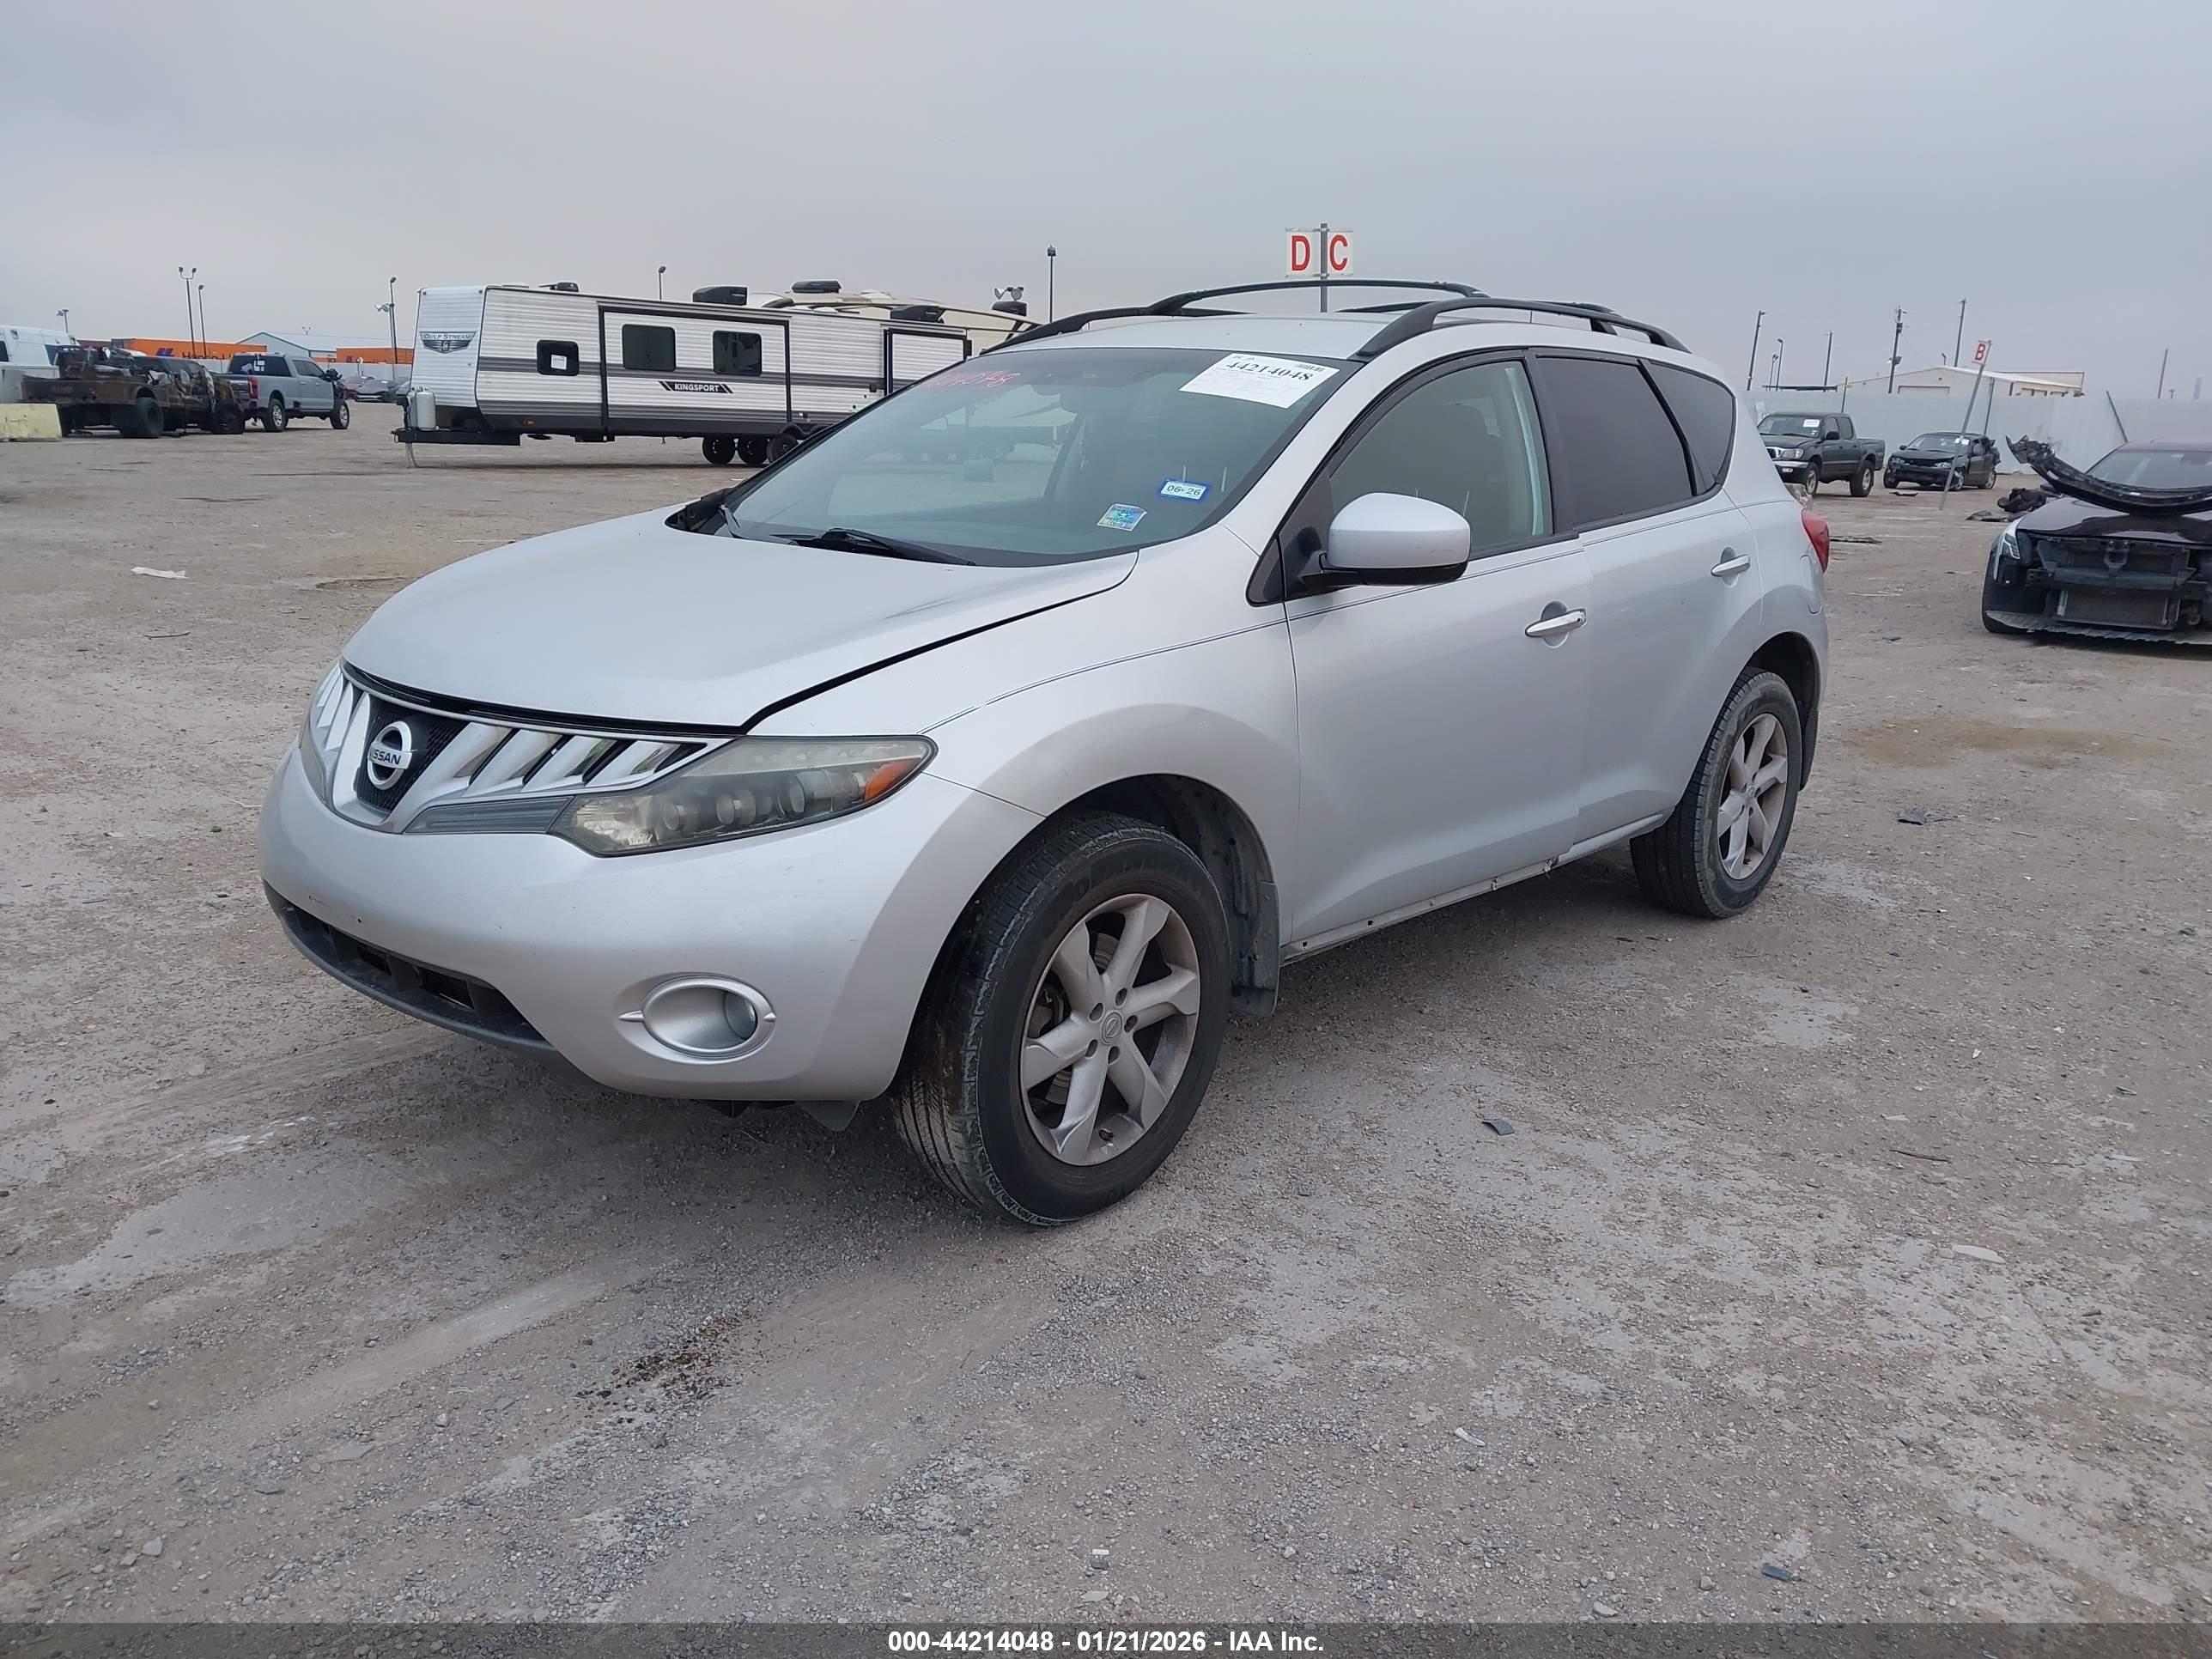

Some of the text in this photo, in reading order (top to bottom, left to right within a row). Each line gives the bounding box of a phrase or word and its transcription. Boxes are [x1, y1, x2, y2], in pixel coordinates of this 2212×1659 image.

[1291, 235, 1310, 271] D
[1329, 234, 1348, 271] C
[1974, 343, 1986, 361] B
[1226, 362, 1314, 380] 44214048
[674, 383, 720, 392] KINGSPORT
